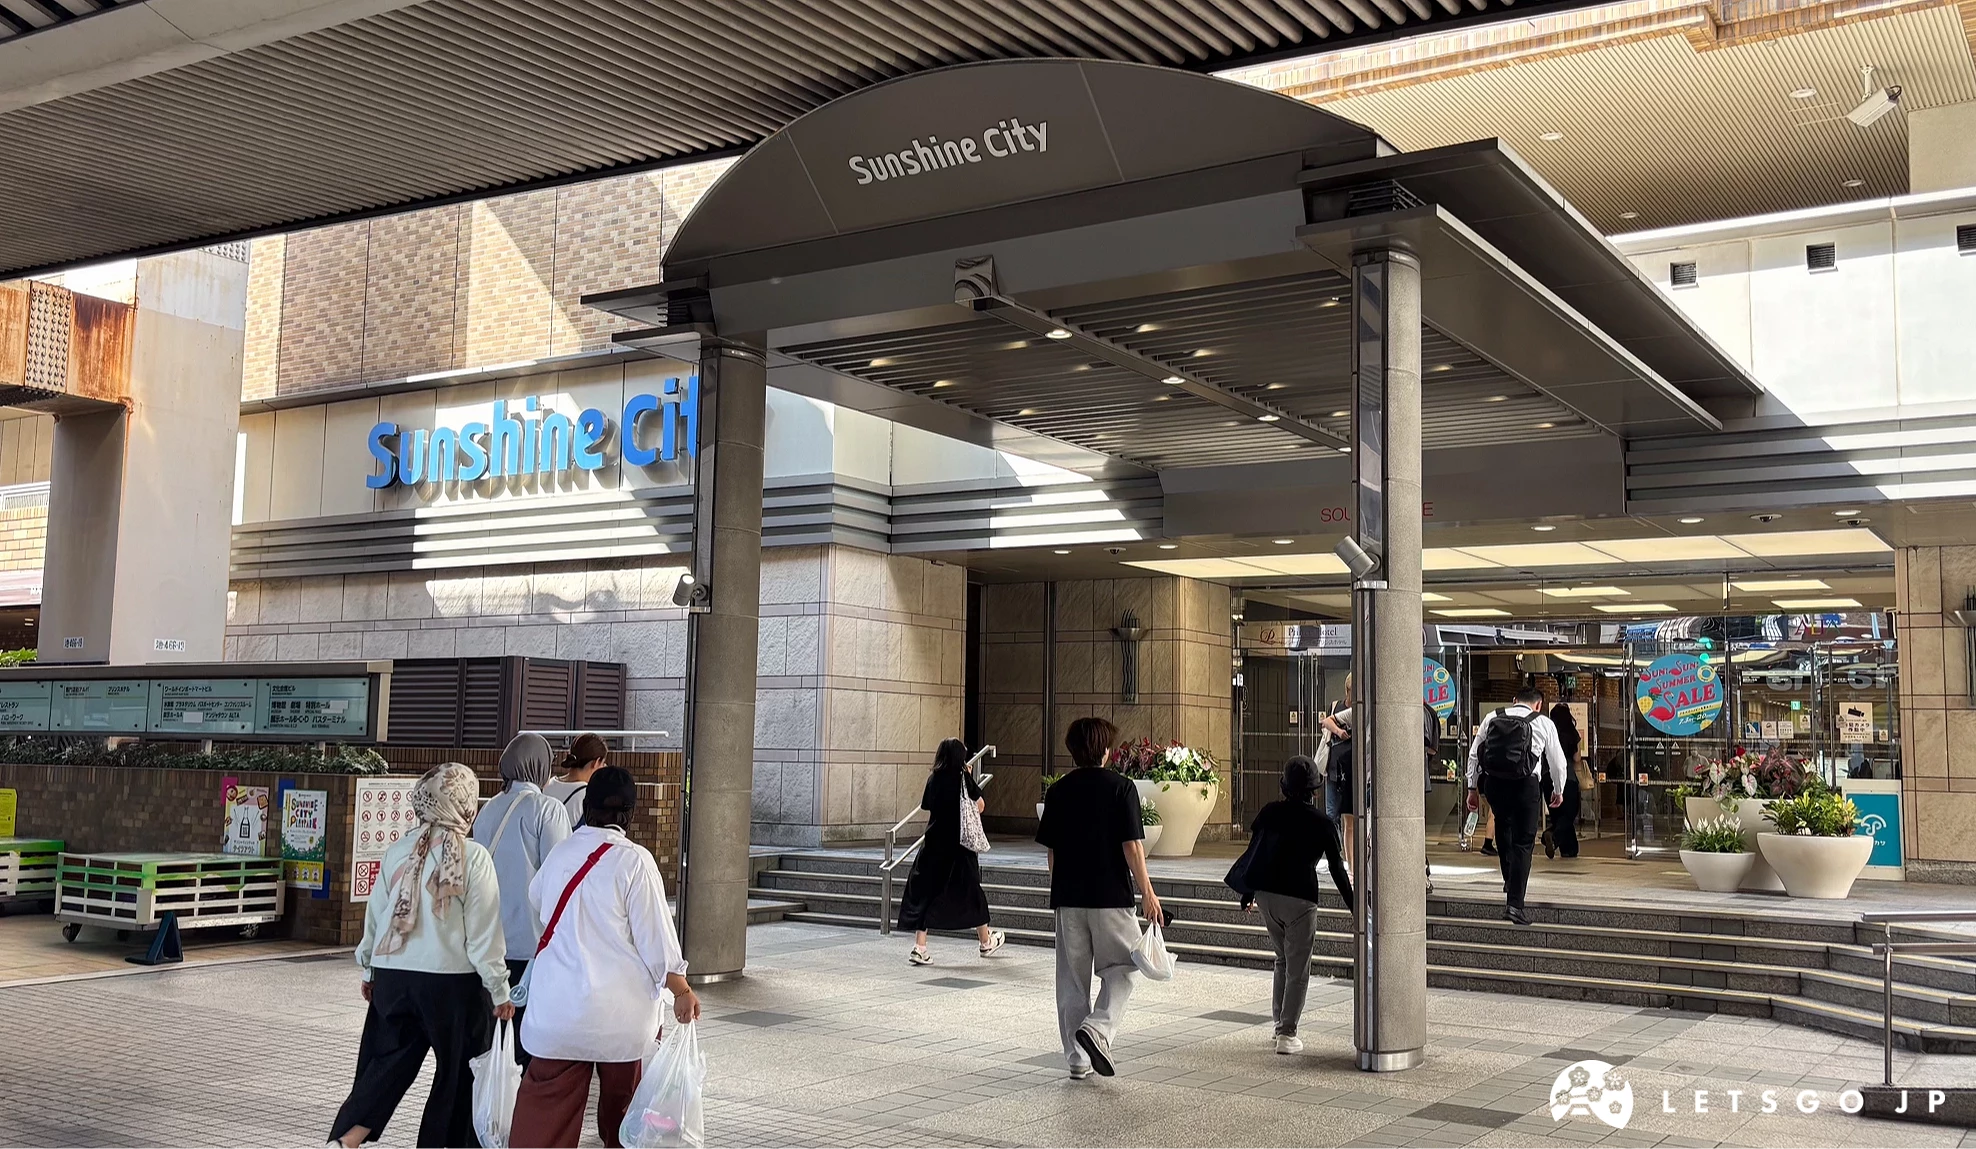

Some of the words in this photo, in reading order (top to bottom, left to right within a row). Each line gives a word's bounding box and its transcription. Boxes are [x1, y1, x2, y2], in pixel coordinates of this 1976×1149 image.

[848, 135, 982, 185] Sunshine
[983, 117, 1048, 158] City
[366, 395, 606, 489] Sunshine
[622, 375, 698, 466] Cit
[1425, 684, 1450, 705] LE
[1649, 674, 1696, 695] SUMMER
[0, 701, 20, 709] レストラン
[1648, 684, 1716, 722] SALE
[312, 715, 346, 724] バスターミナル
[295, 809, 313, 818] CITY
